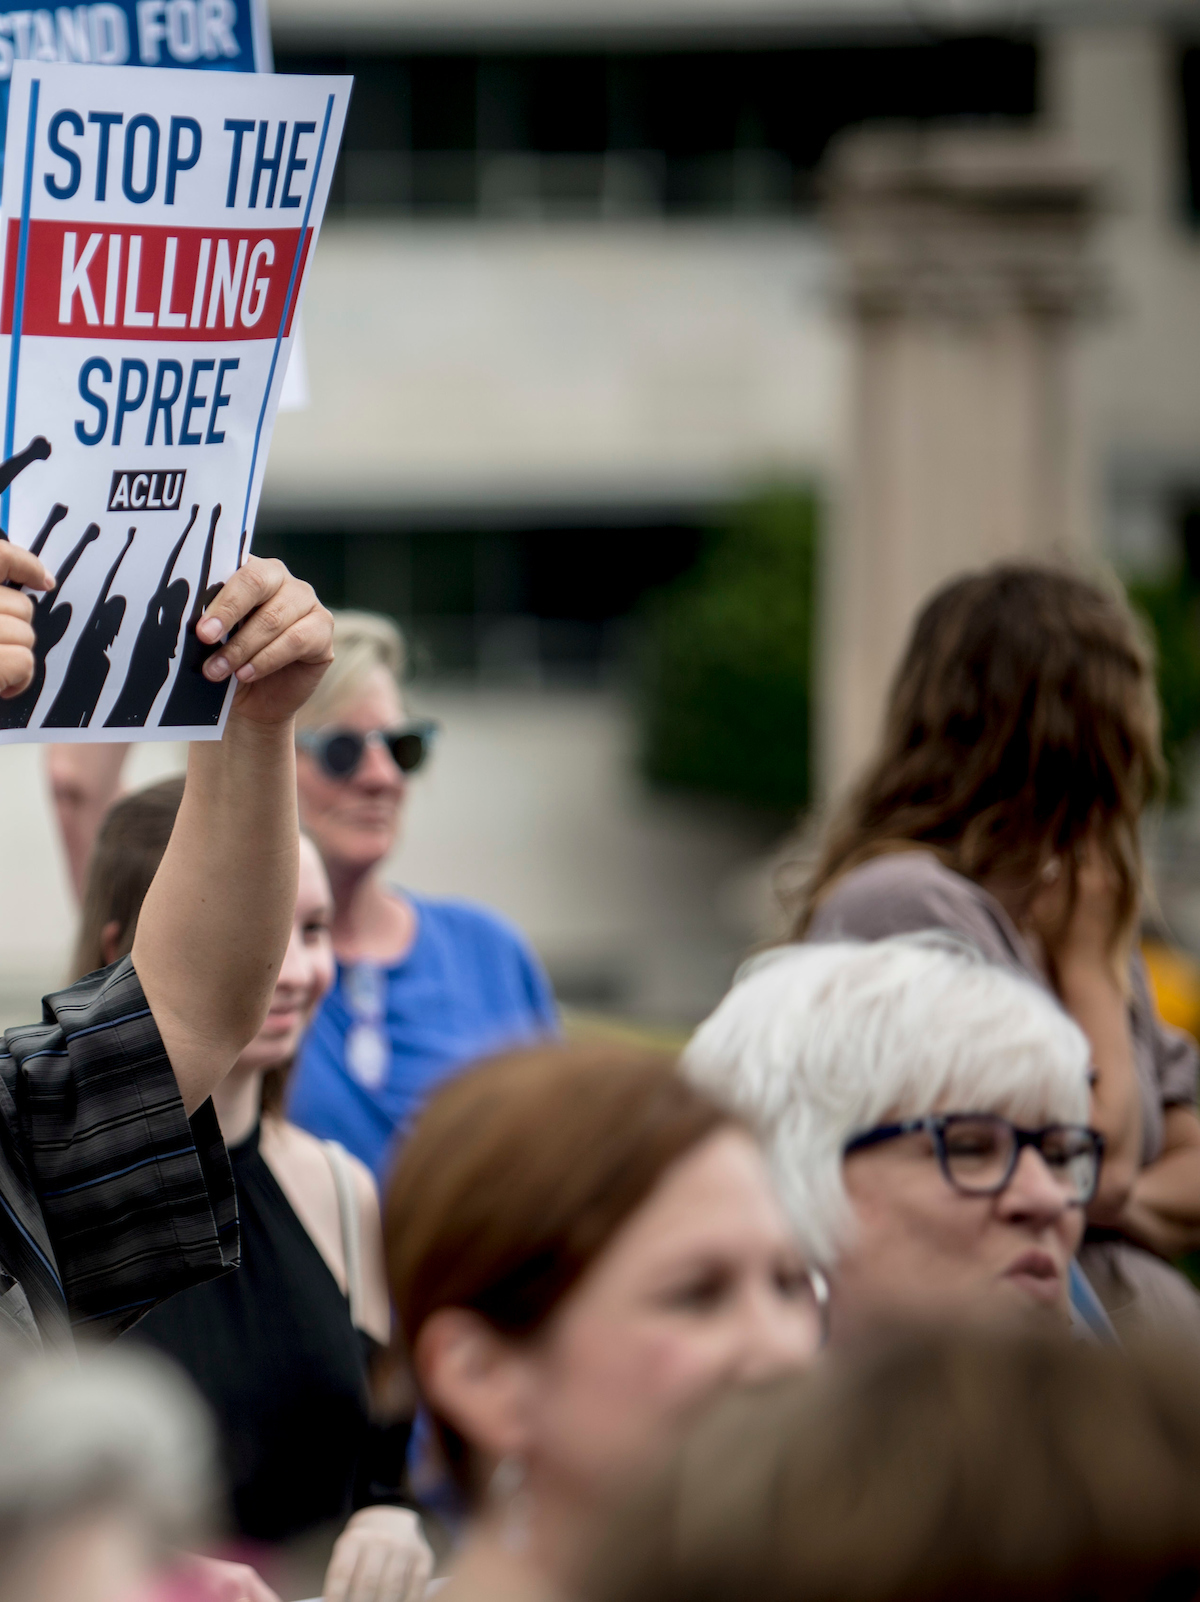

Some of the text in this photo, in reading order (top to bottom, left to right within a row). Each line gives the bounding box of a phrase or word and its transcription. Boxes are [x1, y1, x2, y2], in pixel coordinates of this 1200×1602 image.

[136, 0, 241, 65] FOR
[43, 108, 317, 209] STOP THE
[58, 231, 276, 328] KILLING
[74, 355, 241, 446] SPREE
[110, 473, 183, 509] ACLU
